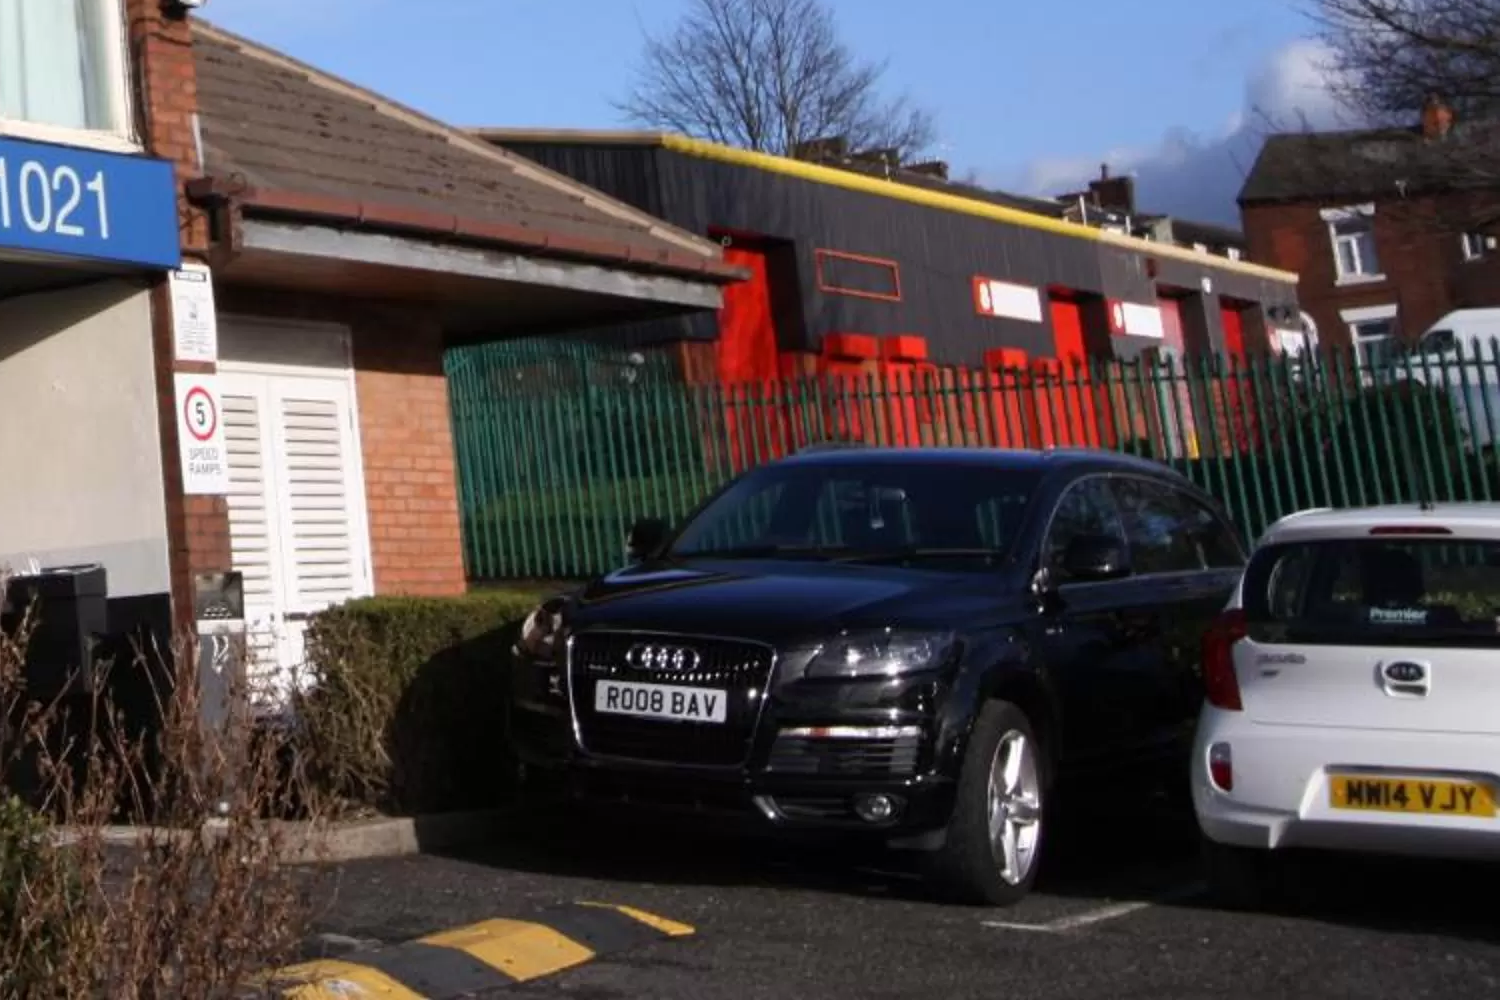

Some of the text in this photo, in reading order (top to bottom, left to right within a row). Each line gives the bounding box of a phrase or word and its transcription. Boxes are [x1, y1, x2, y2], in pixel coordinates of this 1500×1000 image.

[195, 401, 206, 426] 5
[189, 462, 223, 475] RAMPS
[1369, 607, 1428, 622] Premier
[671, 692, 717, 717] BAV
[1418, 783, 1476, 812] VJY
